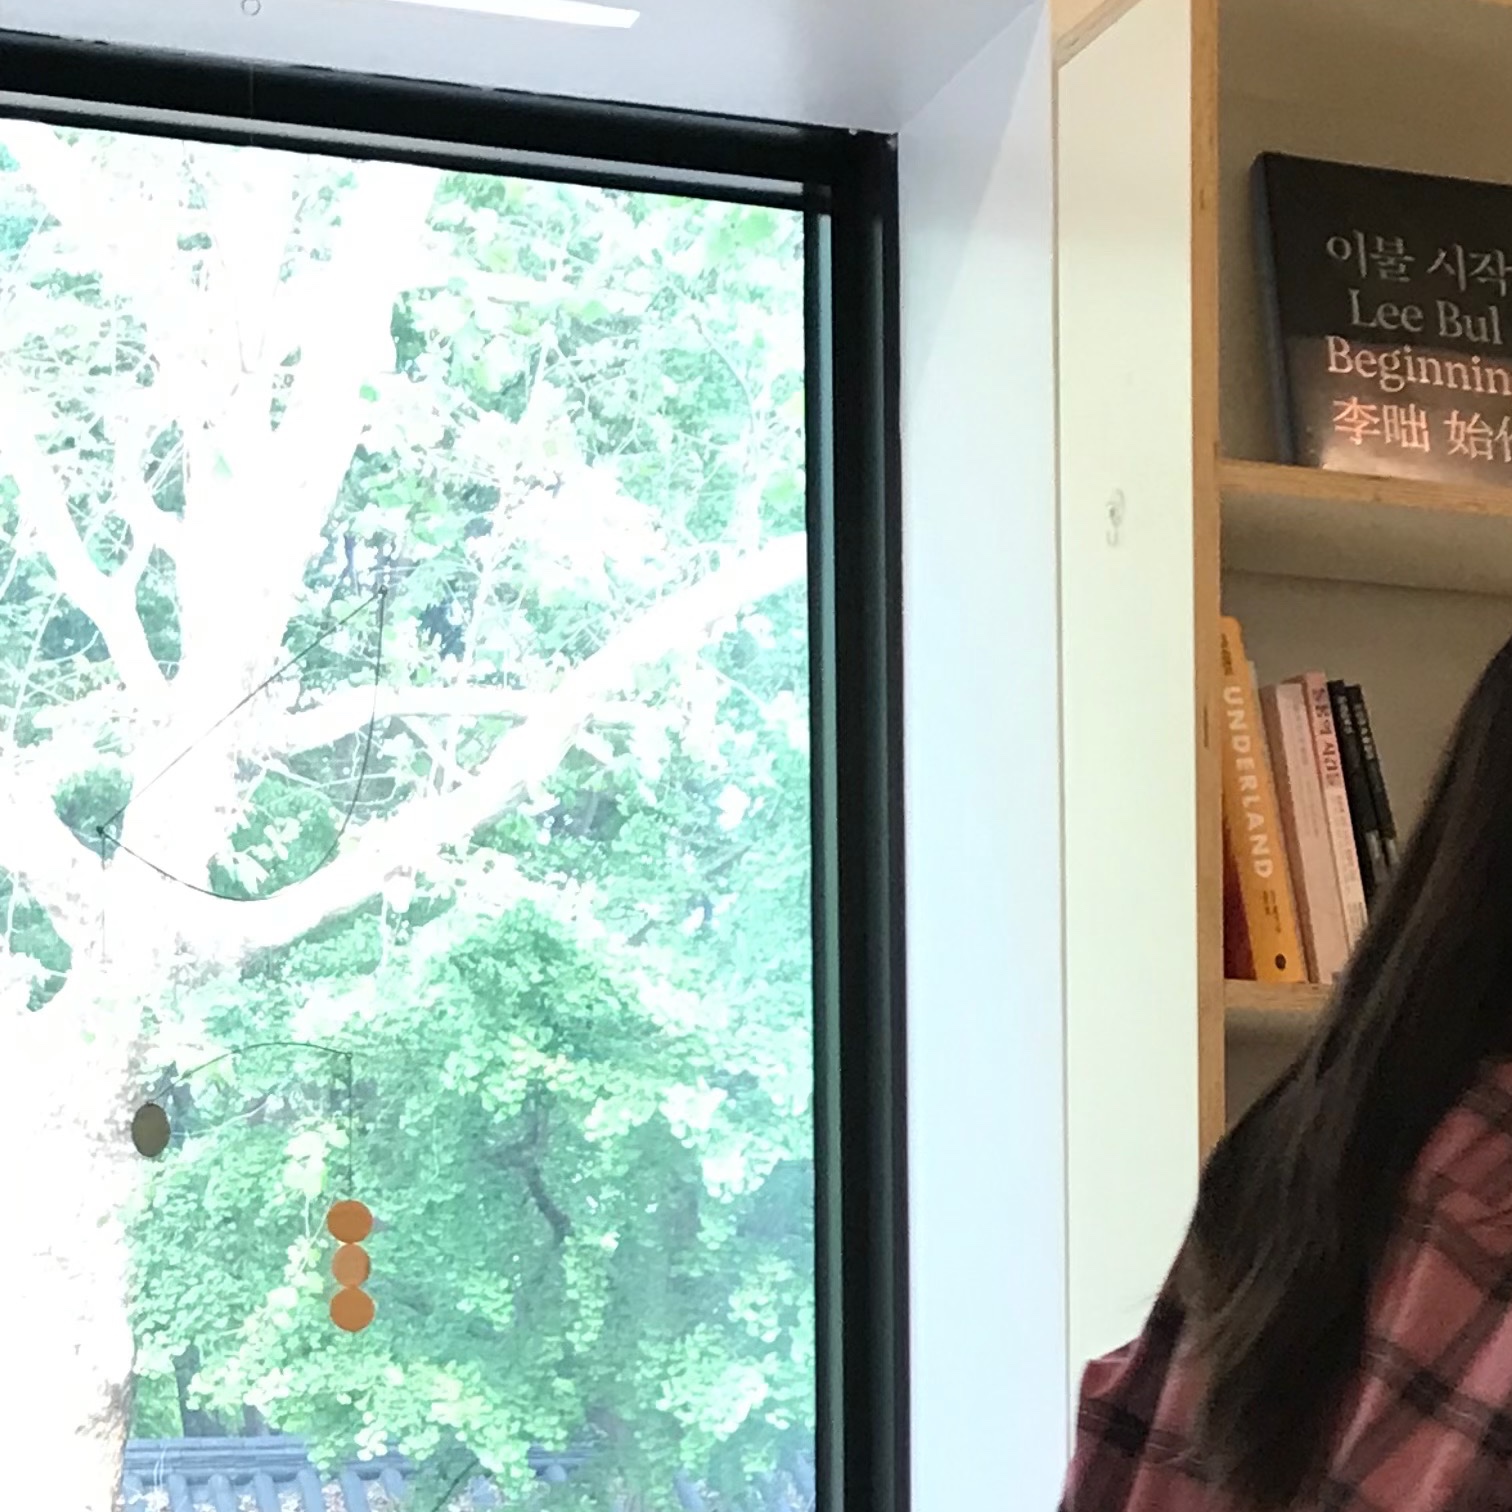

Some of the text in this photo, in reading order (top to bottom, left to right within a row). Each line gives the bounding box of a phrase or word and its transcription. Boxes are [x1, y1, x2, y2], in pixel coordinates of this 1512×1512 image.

[1325, 228, 1412, 284] 이불
[1348, 288, 1503, 345] Lee Bul
[1222, 685, 1274, 880] UNDERLAND
